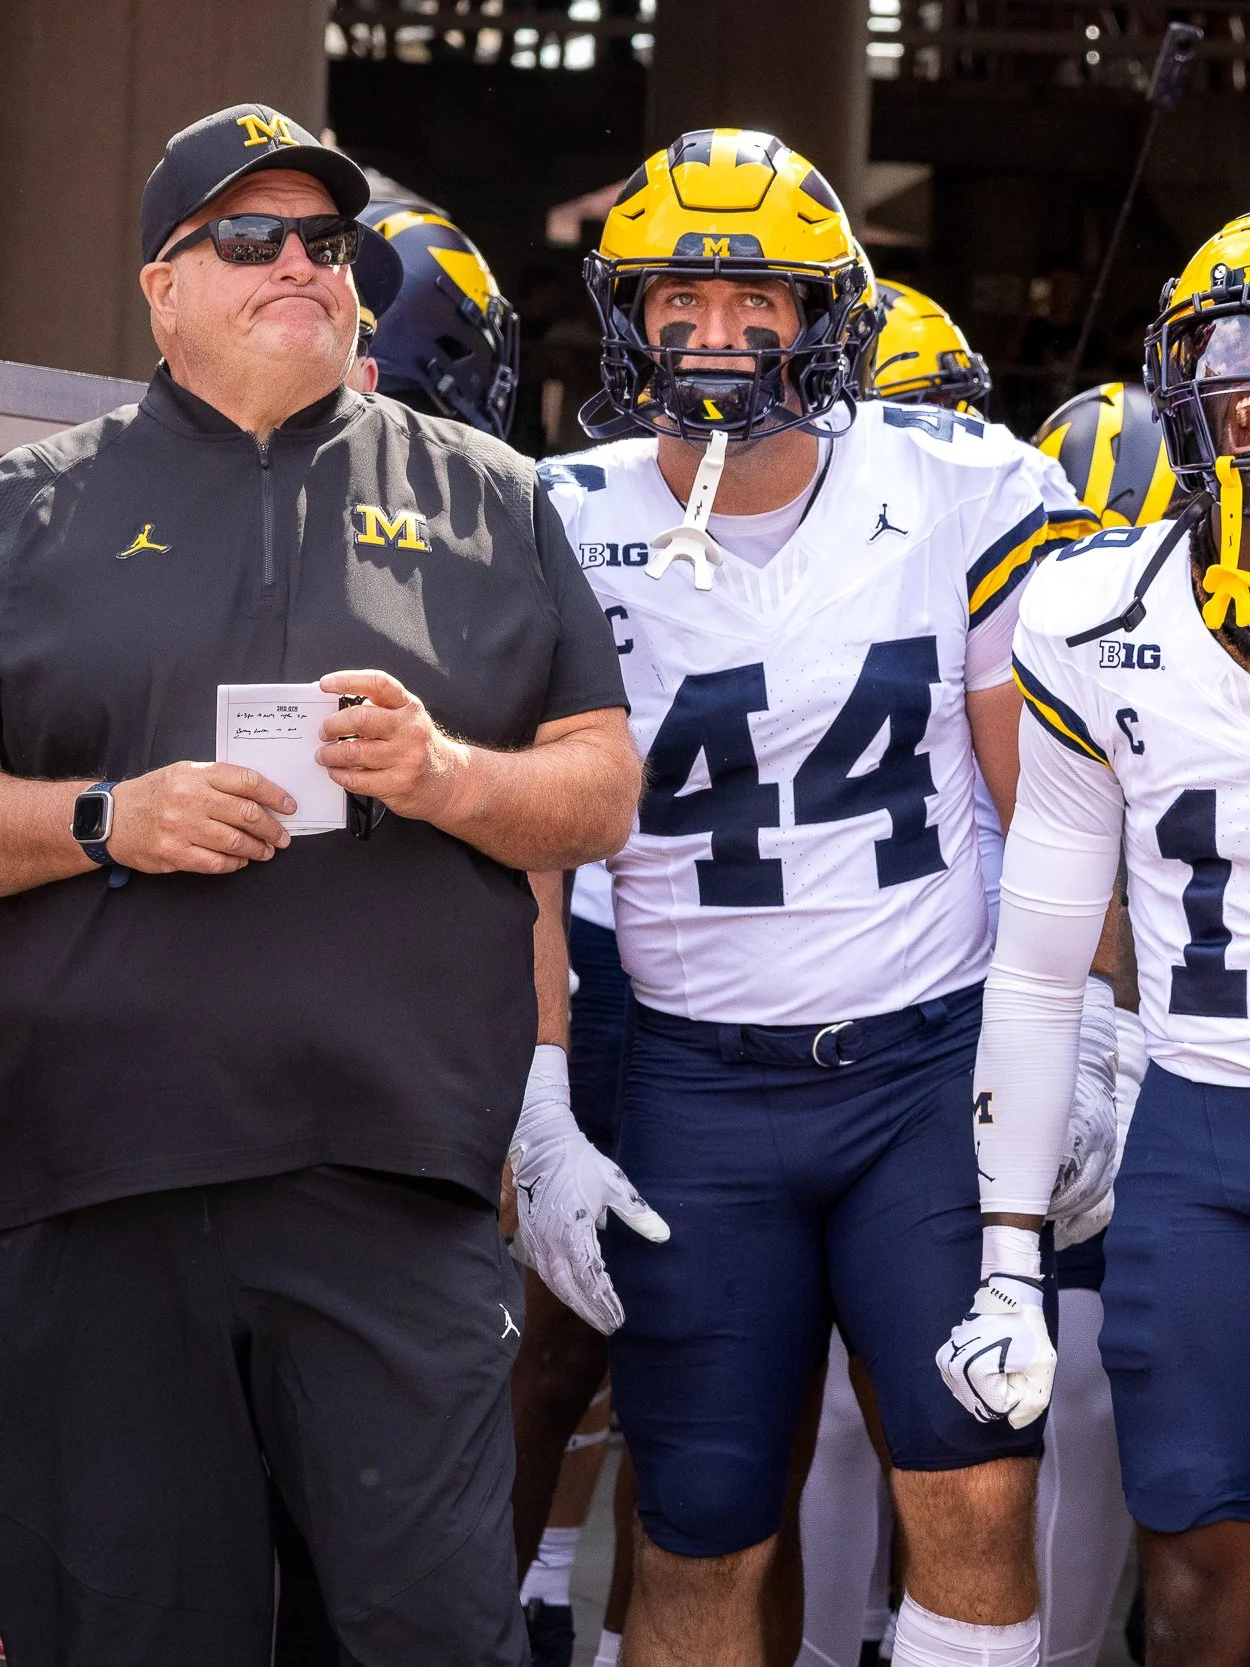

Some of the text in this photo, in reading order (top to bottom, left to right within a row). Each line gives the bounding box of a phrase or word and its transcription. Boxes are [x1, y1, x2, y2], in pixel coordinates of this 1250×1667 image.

[236, 114, 300, 147] M
[702, 237, 731, 257] M
[354, 502, 432, 553] M
[605, 605, 634, 654] C
[1115, 707, 1146, 756] C
[638, 635, 950, 908] 44
